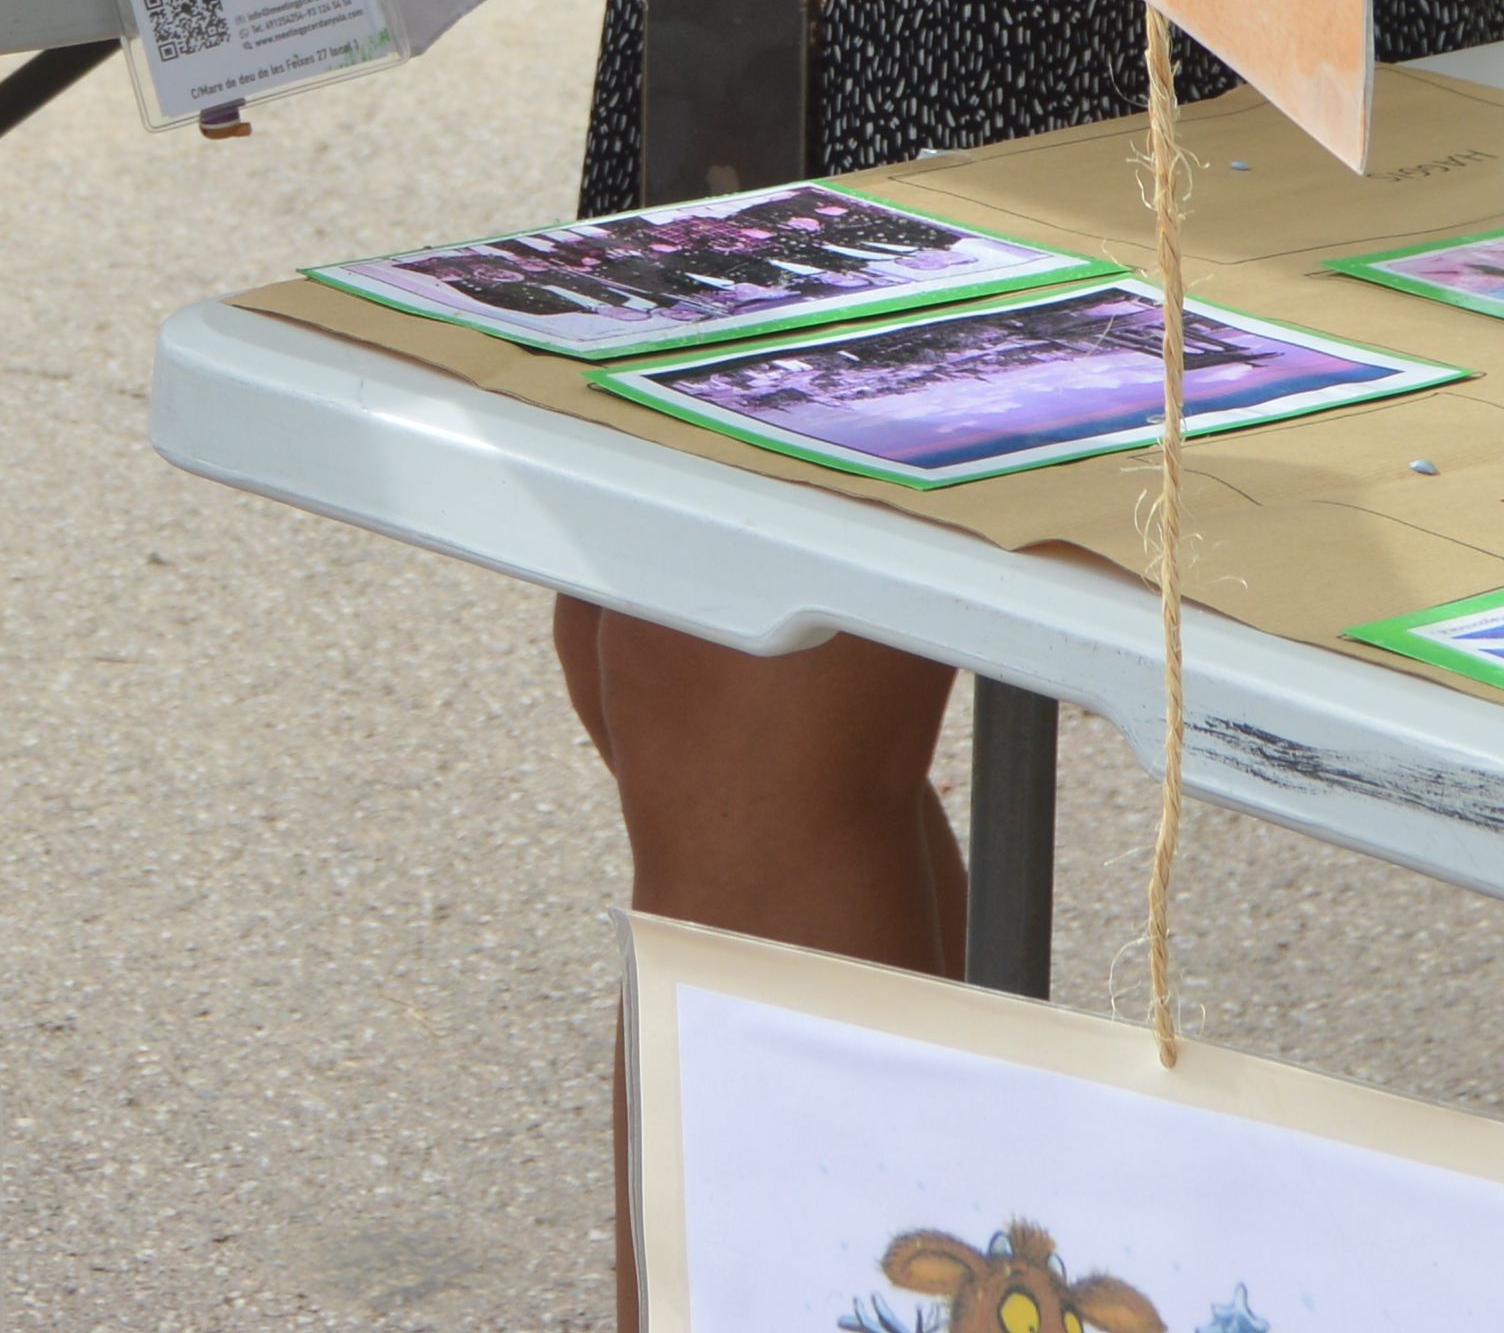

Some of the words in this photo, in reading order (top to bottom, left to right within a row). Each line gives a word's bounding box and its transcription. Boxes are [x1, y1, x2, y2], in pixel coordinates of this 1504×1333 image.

[190, 82, 224, 101] C/Mare
[225, 77, 237, 90] de
[239, 71, 256, 85] deu
[258, 67, 269, 79] de
[271, 62, 285, 76] les
[286, 52, 316, 72] Feixes
[317, 49, 328, 62] 27
[329, 41, 352, 58] local
[1365, 147, 1500, 183] HAGGIS
